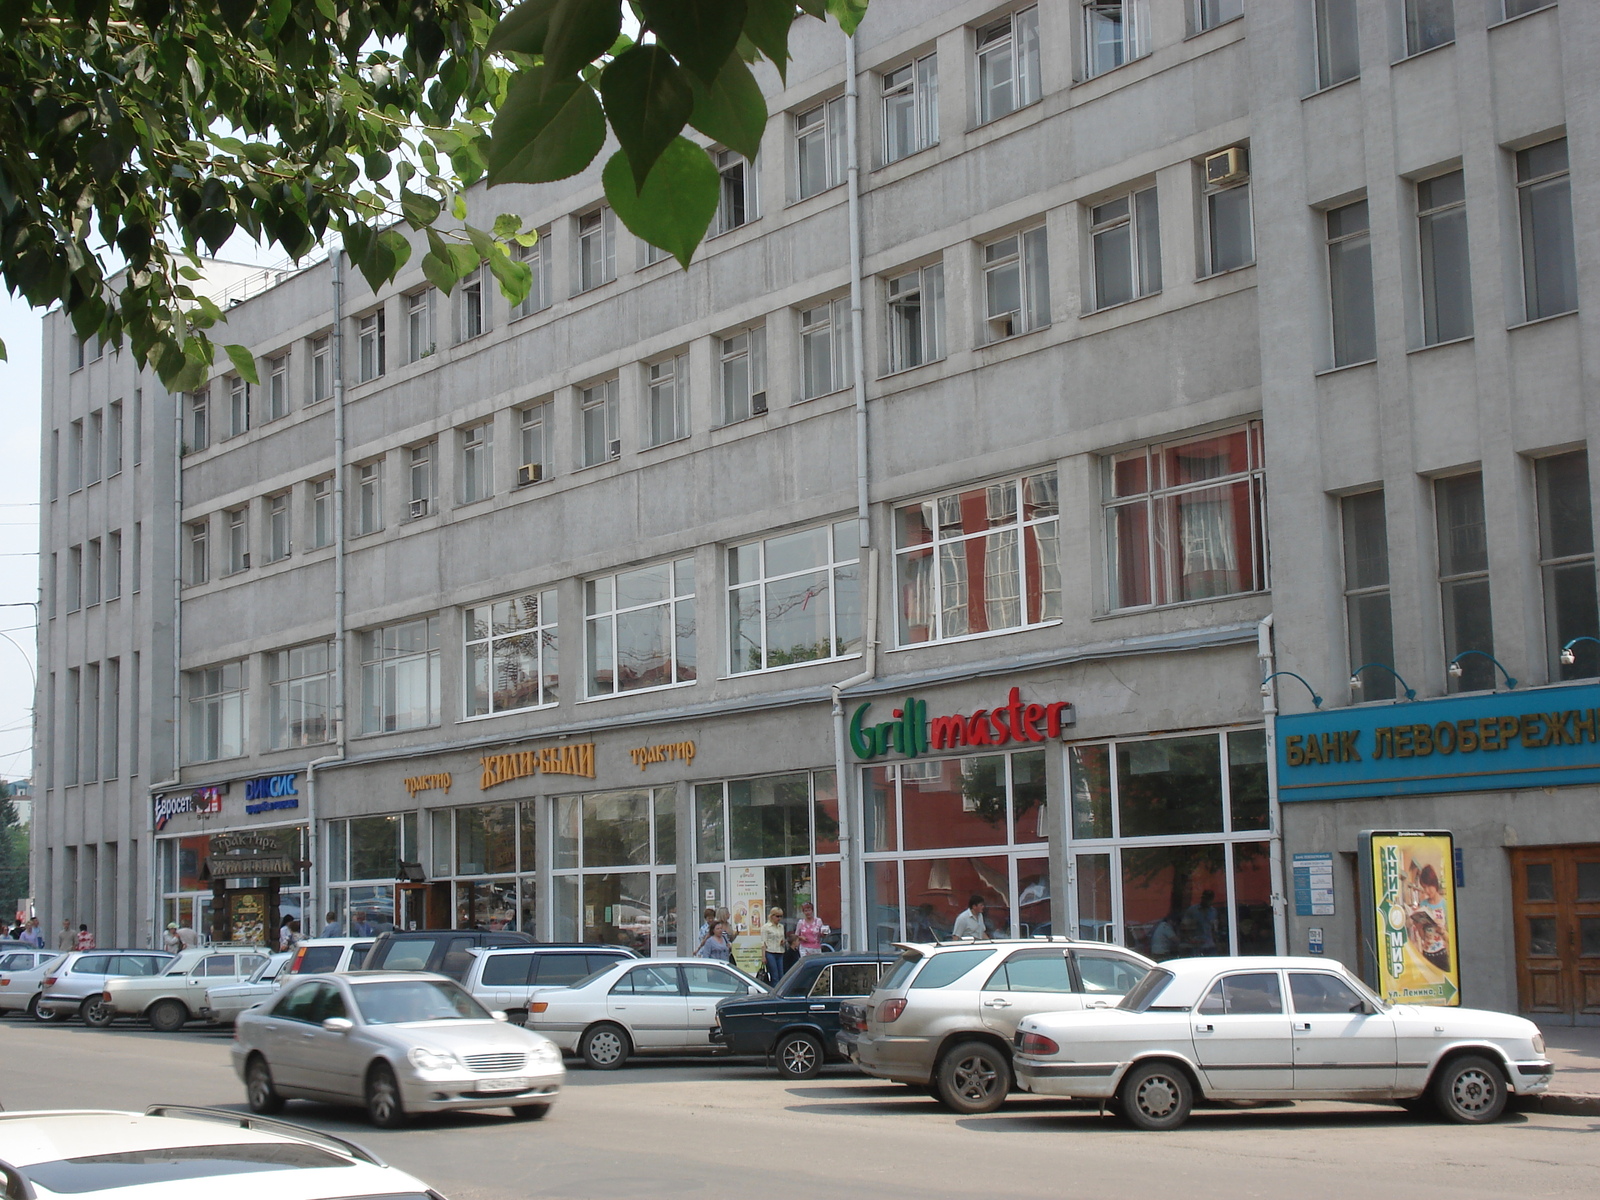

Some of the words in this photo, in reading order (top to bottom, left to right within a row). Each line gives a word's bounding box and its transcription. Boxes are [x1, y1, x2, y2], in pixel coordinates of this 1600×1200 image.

[1286, 730, 1362, 767] БАНК
[1372, 707, 1600, 761] ЛЕВОБЕРЕЖН
[404, 772, 452, 798] трактир
[630, 740, 695, 771] трактир
[1388, 991, 1401, 999] ул.
